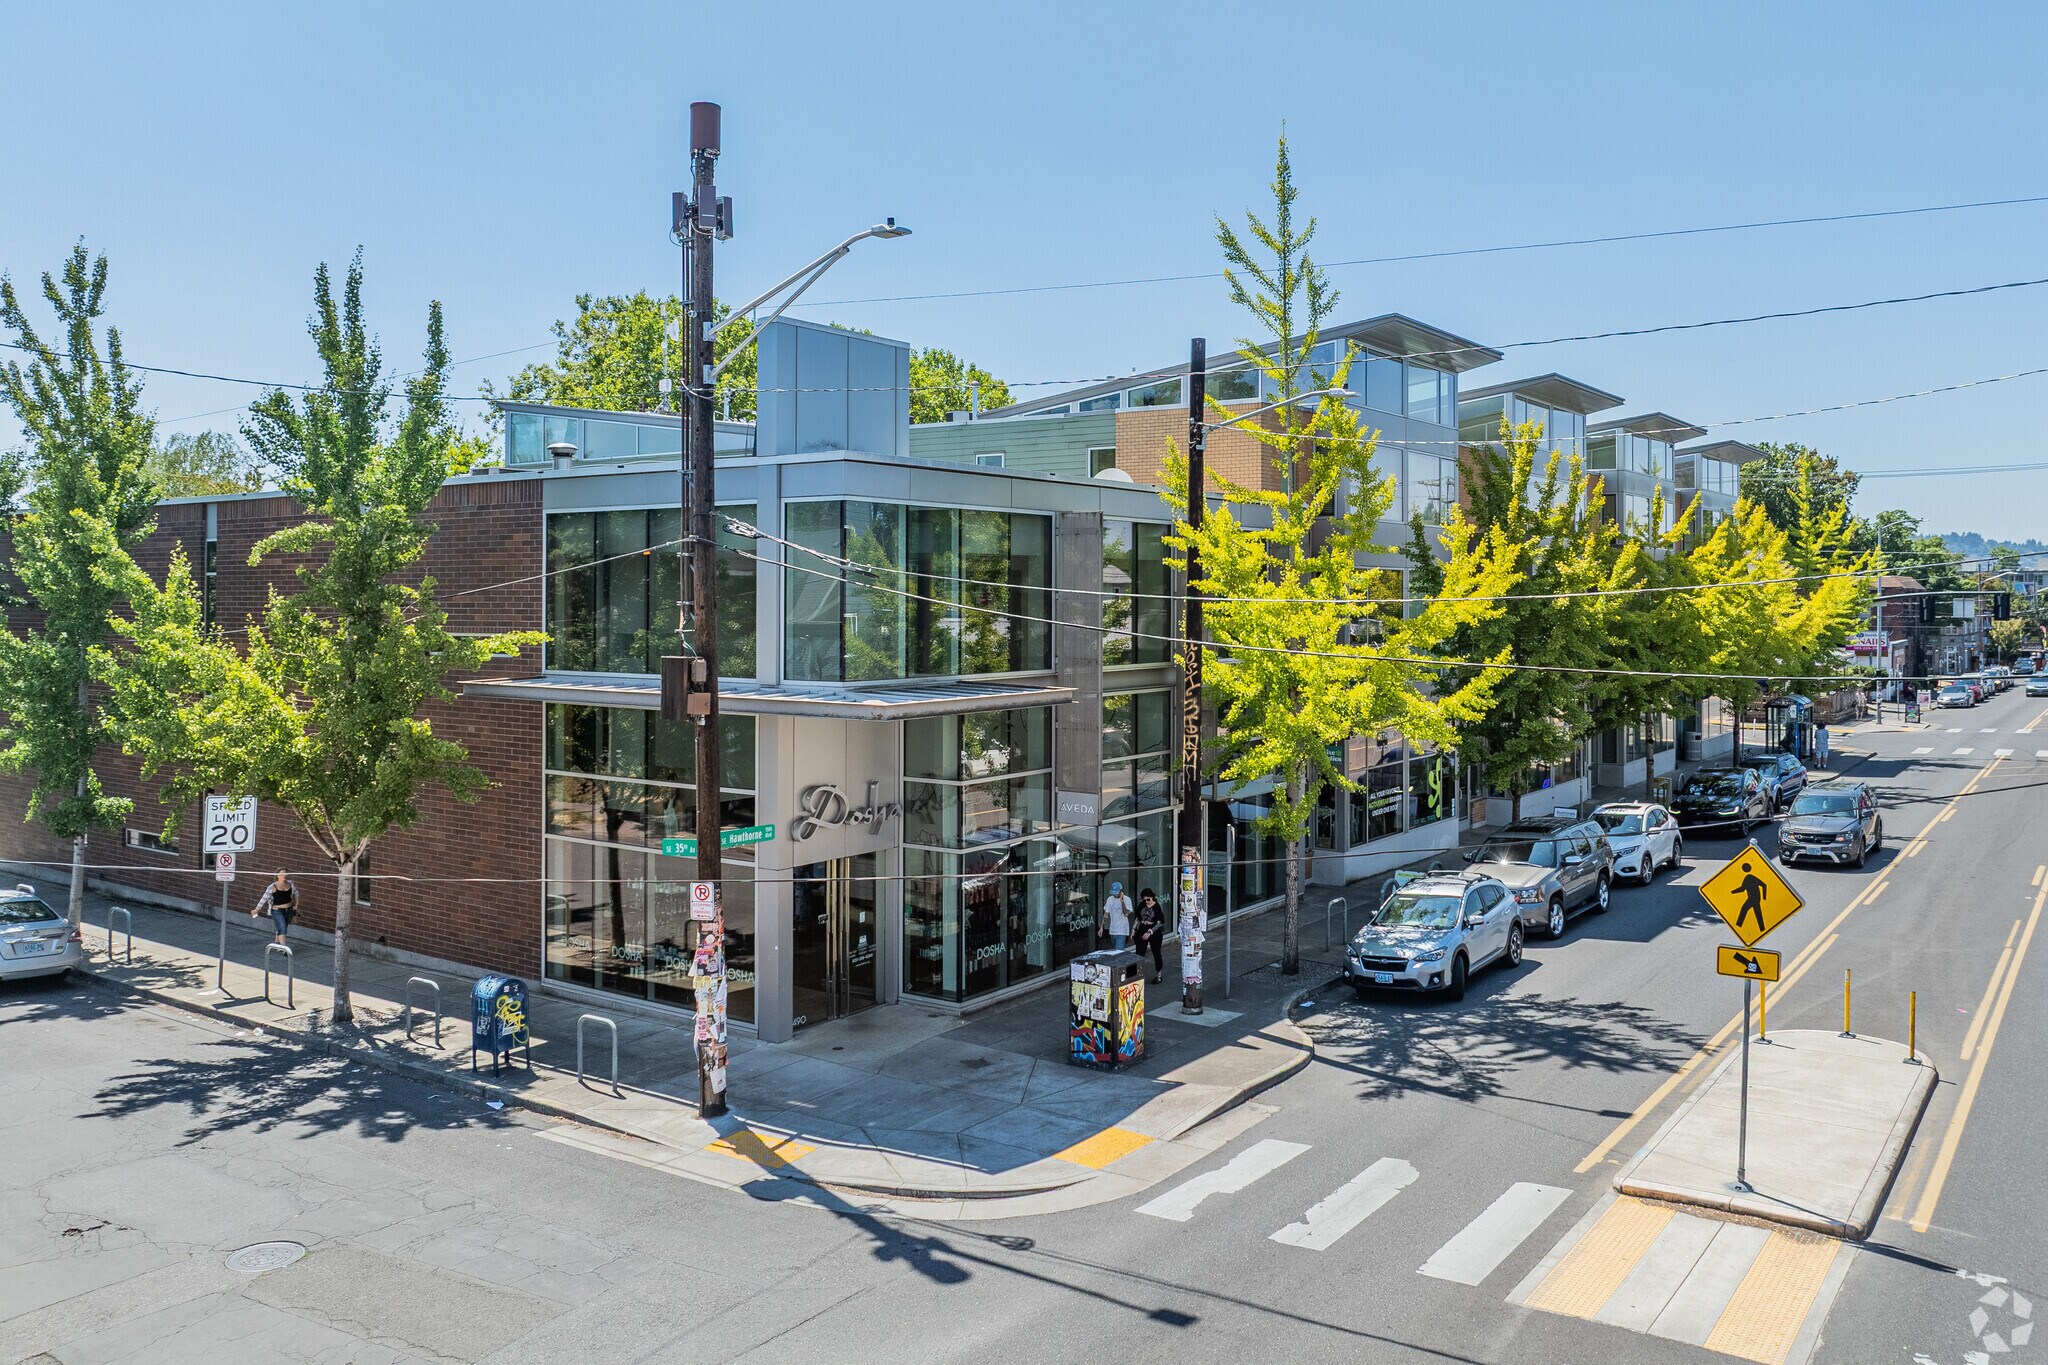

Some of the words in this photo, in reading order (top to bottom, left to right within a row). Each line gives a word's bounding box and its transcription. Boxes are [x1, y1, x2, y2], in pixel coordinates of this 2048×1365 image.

[1060, 803, 1095, 814] AVEDA
[214, 813, 247, 823] LIMIT
[210, 825, 248, 846] 20
[721, 837, 727, 846] SE
[729, 831, 763, 844] Hawthorne
[666, 845, 672, 853] SE
[675, 843, 688, 853] 35th
[1069, 916, 1095, 932] DOSHA
[561, 935, 591, 951] DOSHA
[1025, 928, 1053, 946] DOSHA
[612, 945, 643, 962] DOSHA
[976, 942, 1006, 960] DOSHA
[665, 955, 692, 971] DOSH
[726, 968, 757, 984] OSHA
